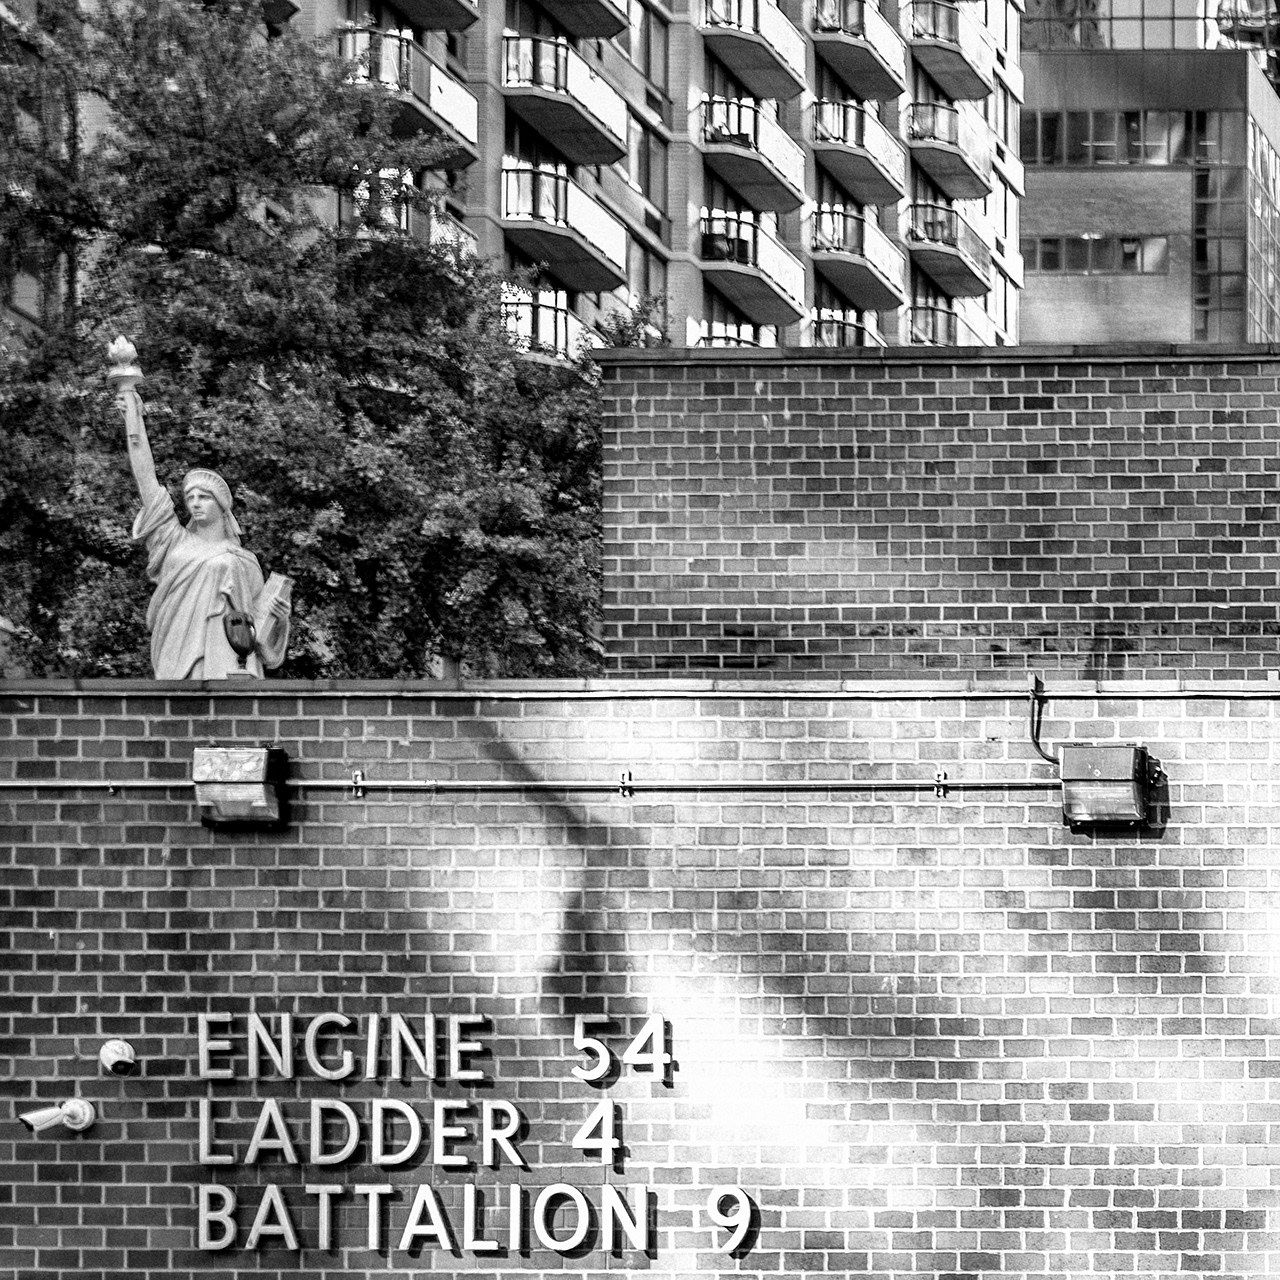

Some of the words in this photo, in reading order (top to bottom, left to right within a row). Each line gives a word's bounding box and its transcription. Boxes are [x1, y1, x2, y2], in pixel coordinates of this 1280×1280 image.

[199, 1012, 487, 1080] ENGINE
[571, 1012, 672, 1081] 54
[200, 1097, 526, 1167] LADDER
[571, 1098, 622, 1166] 4
[199, 1183, 648, 1252] BATTALION
[715, 1186, 754, 1252] 9
